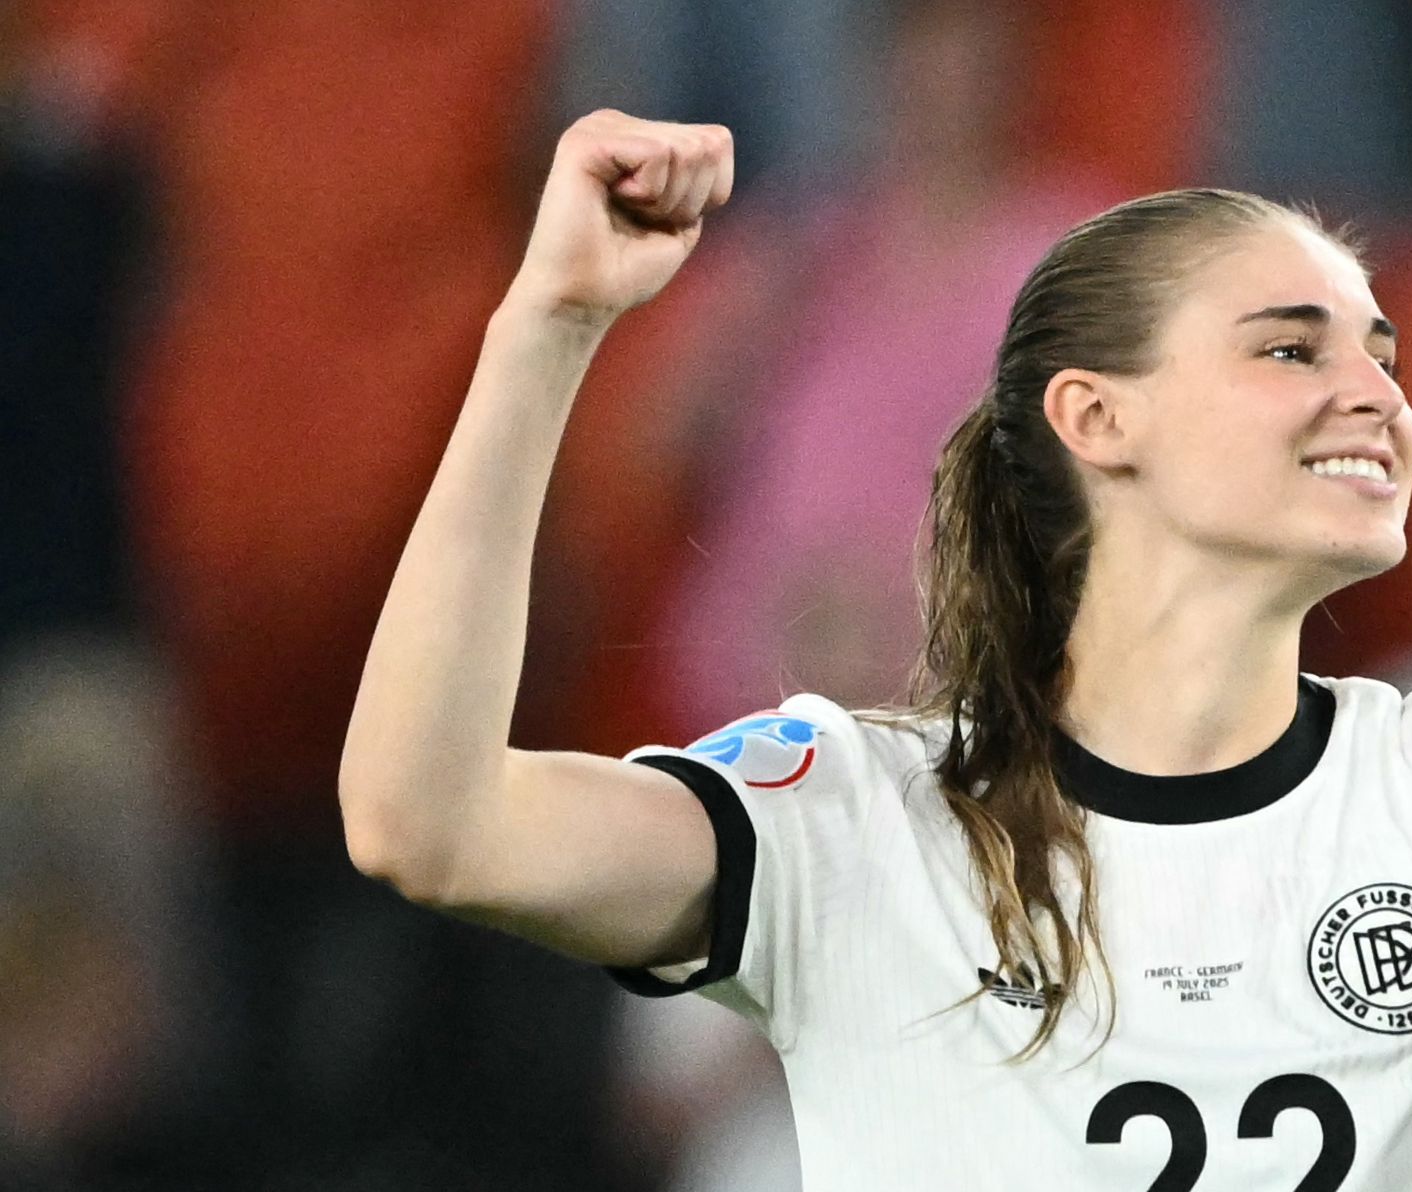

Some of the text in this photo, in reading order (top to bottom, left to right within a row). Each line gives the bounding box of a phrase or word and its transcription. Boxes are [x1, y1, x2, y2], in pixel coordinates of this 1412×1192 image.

[1318, 908, 1369, 1019] DEUTSCHER
[1144, 966, 1184, 979] FRANCE
[1176, 979, 1200, 990] JULY
[1203, 977, 1230, 989] 2025
[1180, 990, 1213, 1003] BASEL
